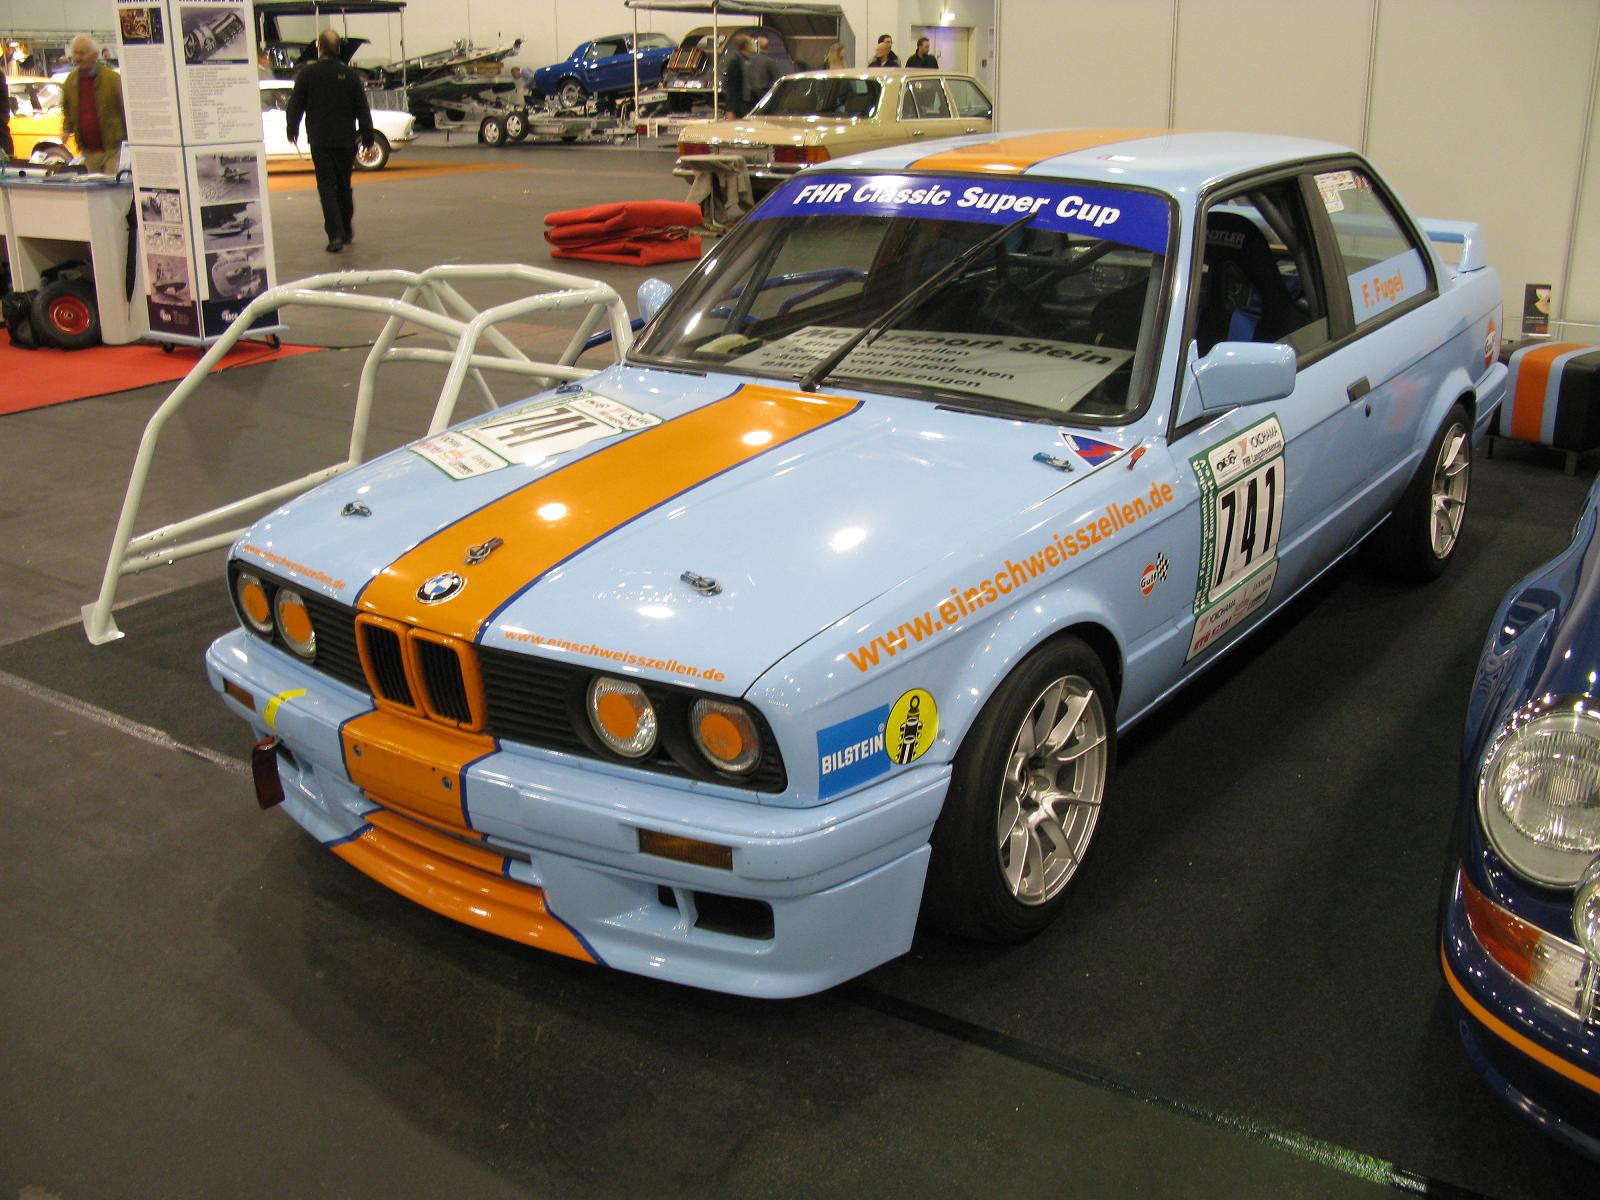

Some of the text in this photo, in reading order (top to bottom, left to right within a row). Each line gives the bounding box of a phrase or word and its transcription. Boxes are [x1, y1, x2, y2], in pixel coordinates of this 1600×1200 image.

[792, 183, 1121, 228] FHR Classic Super Cup
[792, 328, 1113, 365] Morsport Stein
[889, 360, 1015, 380] historischen
[1214, 465, 1276, 588] 741
[846, 480, 1176, 673] www.einschweisszellen.de
[503, 629, 726, 683] www.einschweisszellen.de
[821, 732, 885, 776] BILSTEIN
